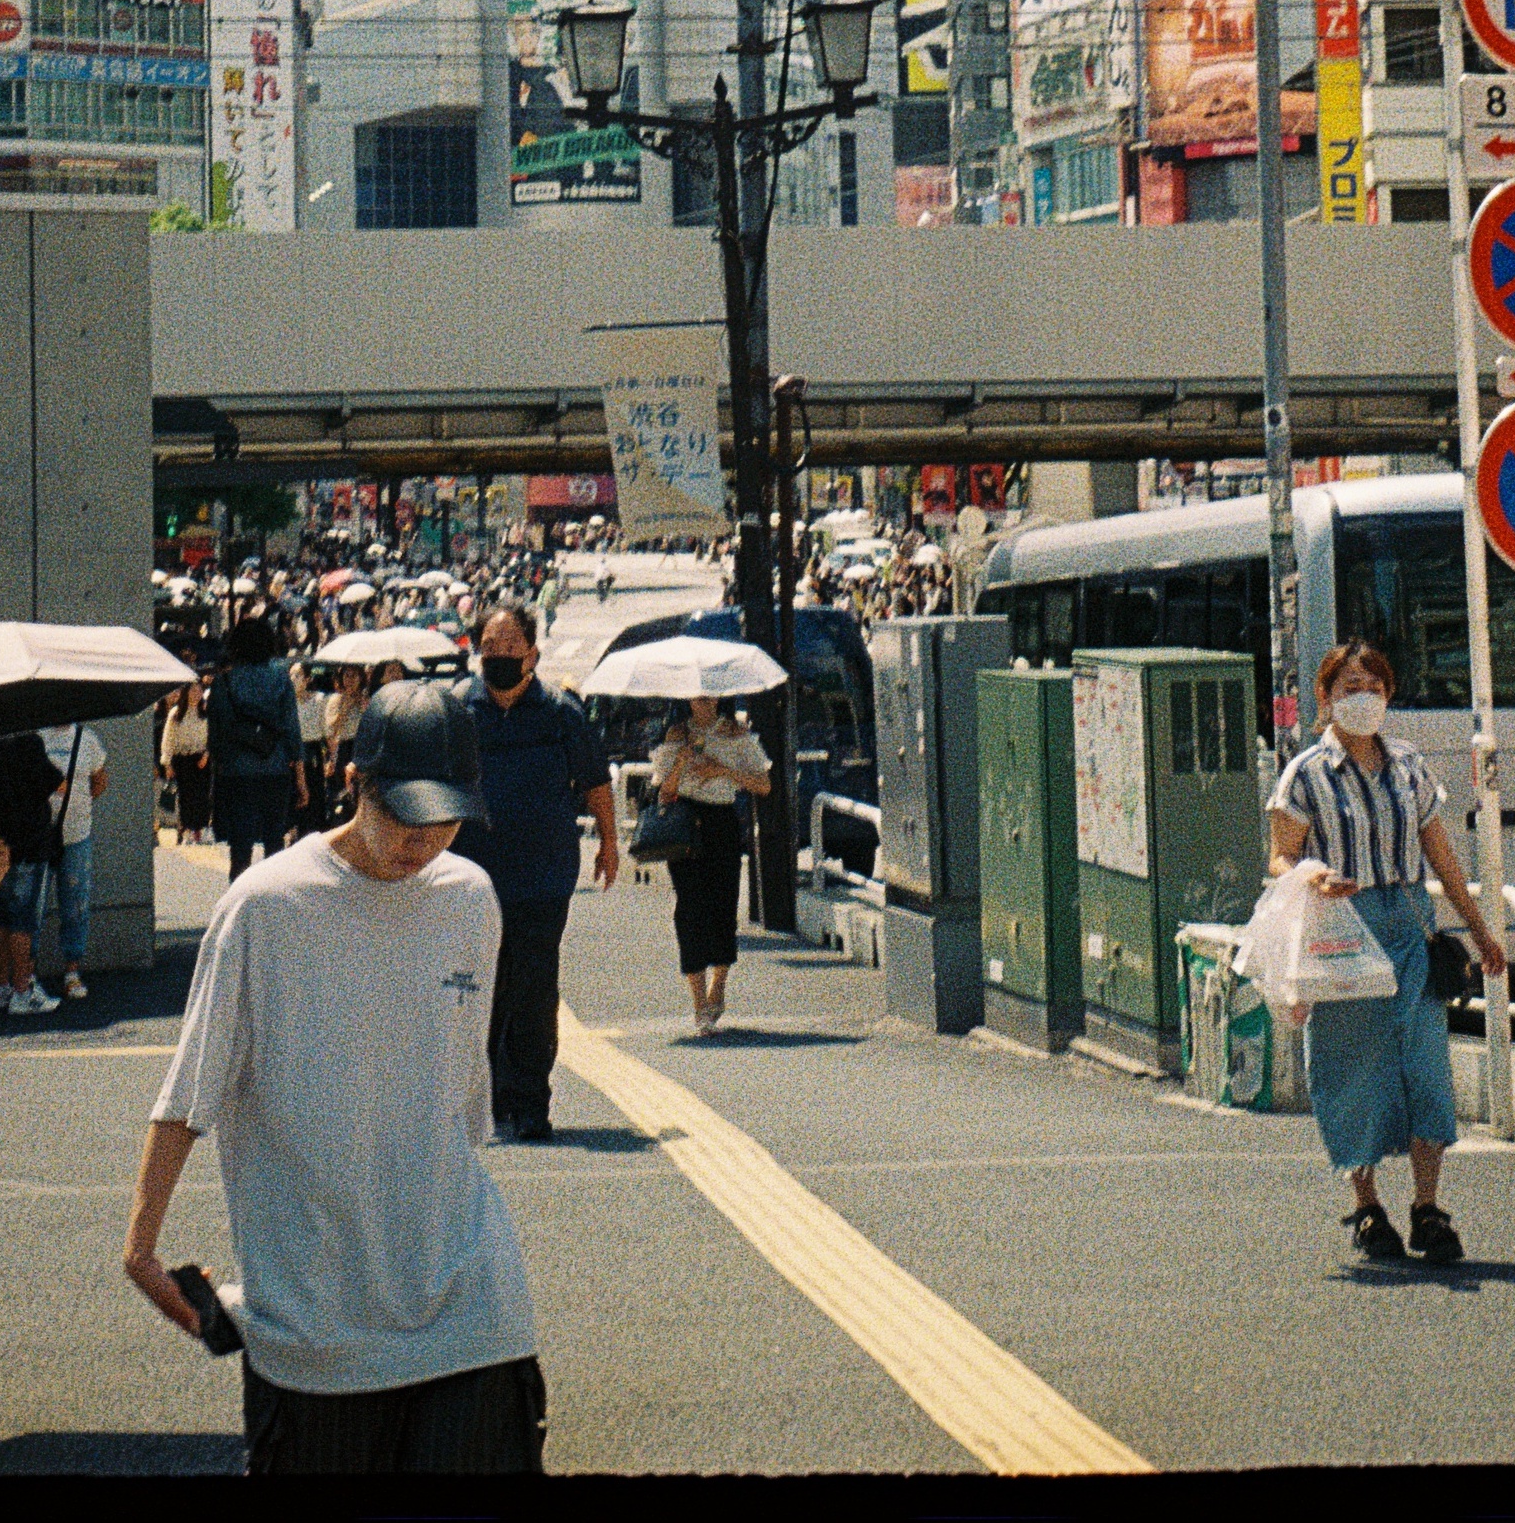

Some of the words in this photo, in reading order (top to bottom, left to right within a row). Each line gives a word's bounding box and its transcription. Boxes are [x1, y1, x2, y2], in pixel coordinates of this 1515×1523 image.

[631, 401, 681, 426] 渋谷
[615, 432, 707, 457] おとなり
